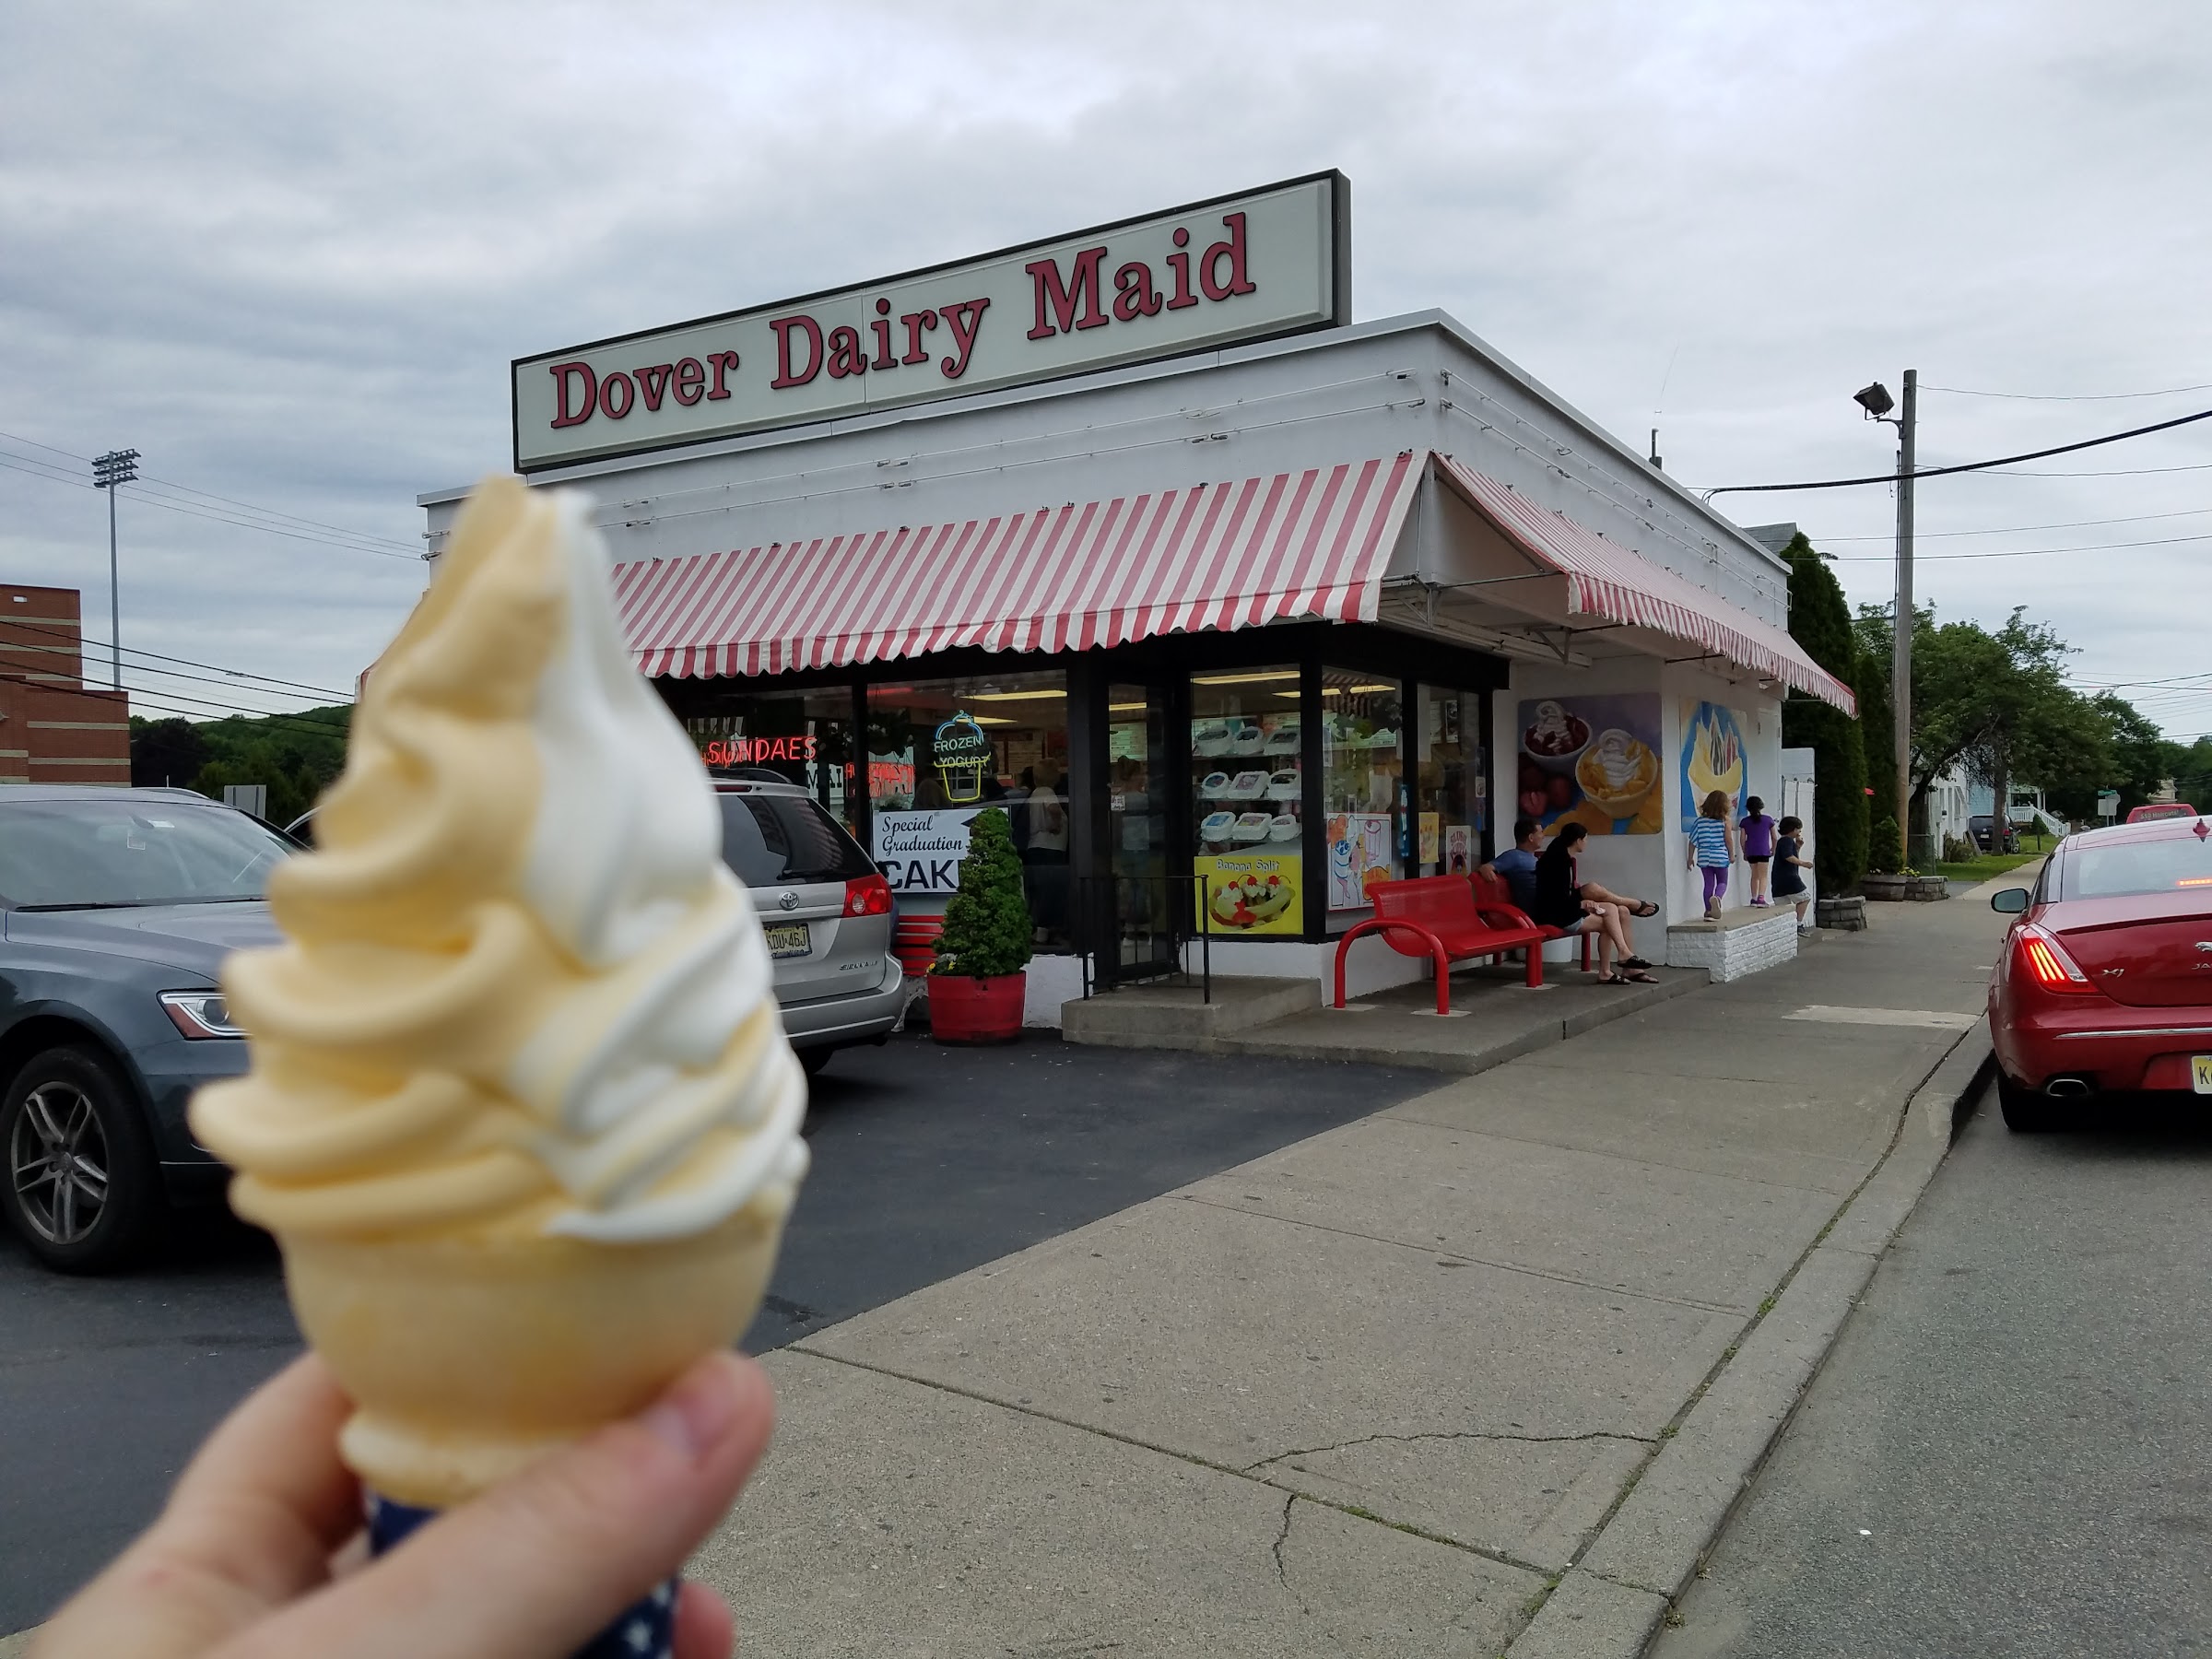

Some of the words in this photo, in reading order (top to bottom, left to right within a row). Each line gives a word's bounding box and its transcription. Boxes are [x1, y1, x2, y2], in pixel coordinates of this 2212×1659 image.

[549, 350, 739, 429] Dover
[770, 297, 991, 390] Dairy
[1025, 211, 1255, 341] Maid
[709, 736, 818, 765] SUNDAES
[934, 735, 982, 753] FROZEN
[940, 756, 991, 769] YOGURT
[882, 815, 934, 837] Special
[882, 835, 963, 857] Graduation
[883, 859, 966, 889] CAK
[1217, 858, 1253, 872] Banana
[1256, 859, 1280, 873] Split
